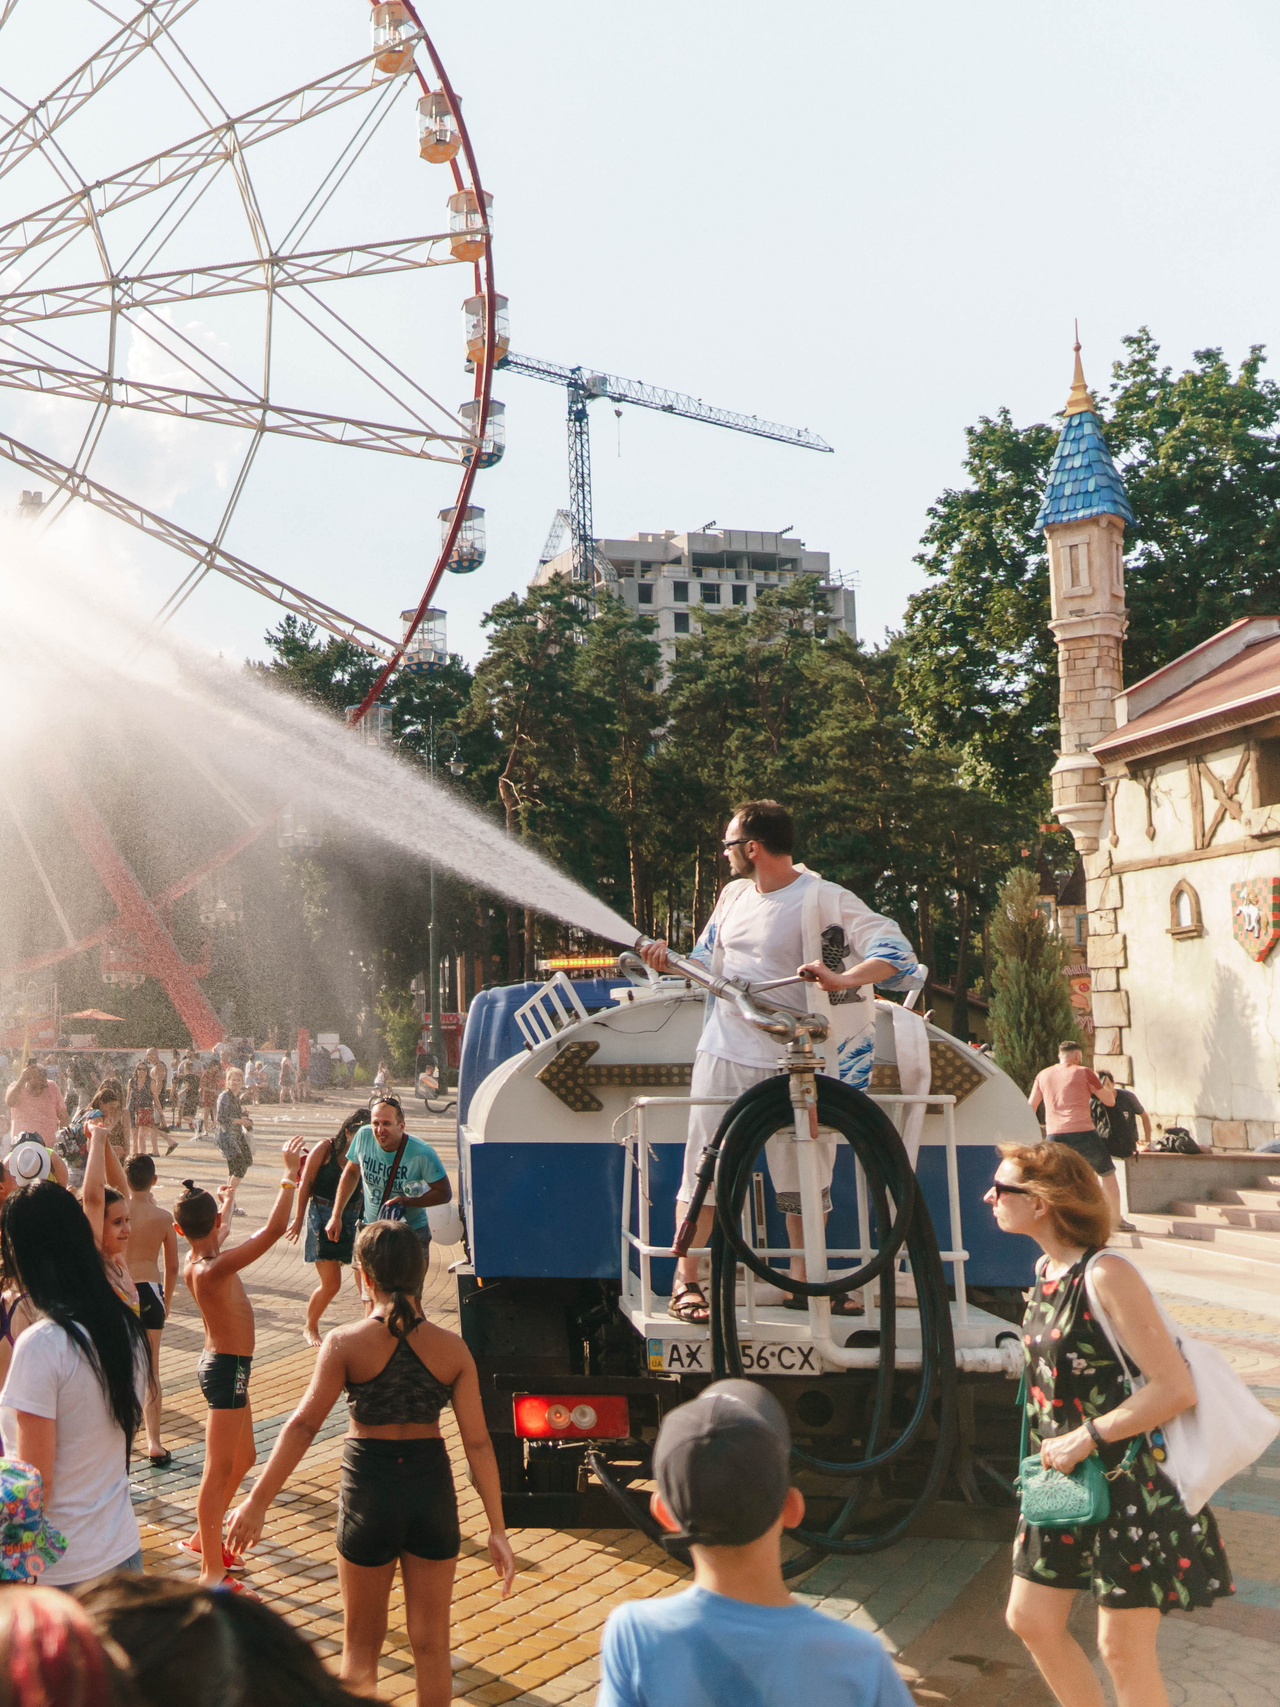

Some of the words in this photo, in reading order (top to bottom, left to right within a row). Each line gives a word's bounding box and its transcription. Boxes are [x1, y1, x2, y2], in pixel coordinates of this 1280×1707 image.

[364, 1171, 381, 1185] NEW
[383, 1178, 404, 1191] YRK
[651, 1360, 663, 1368] UA
[668, 1344, 703, 1368] AX
[777, 1346, 815, 1370] CX
